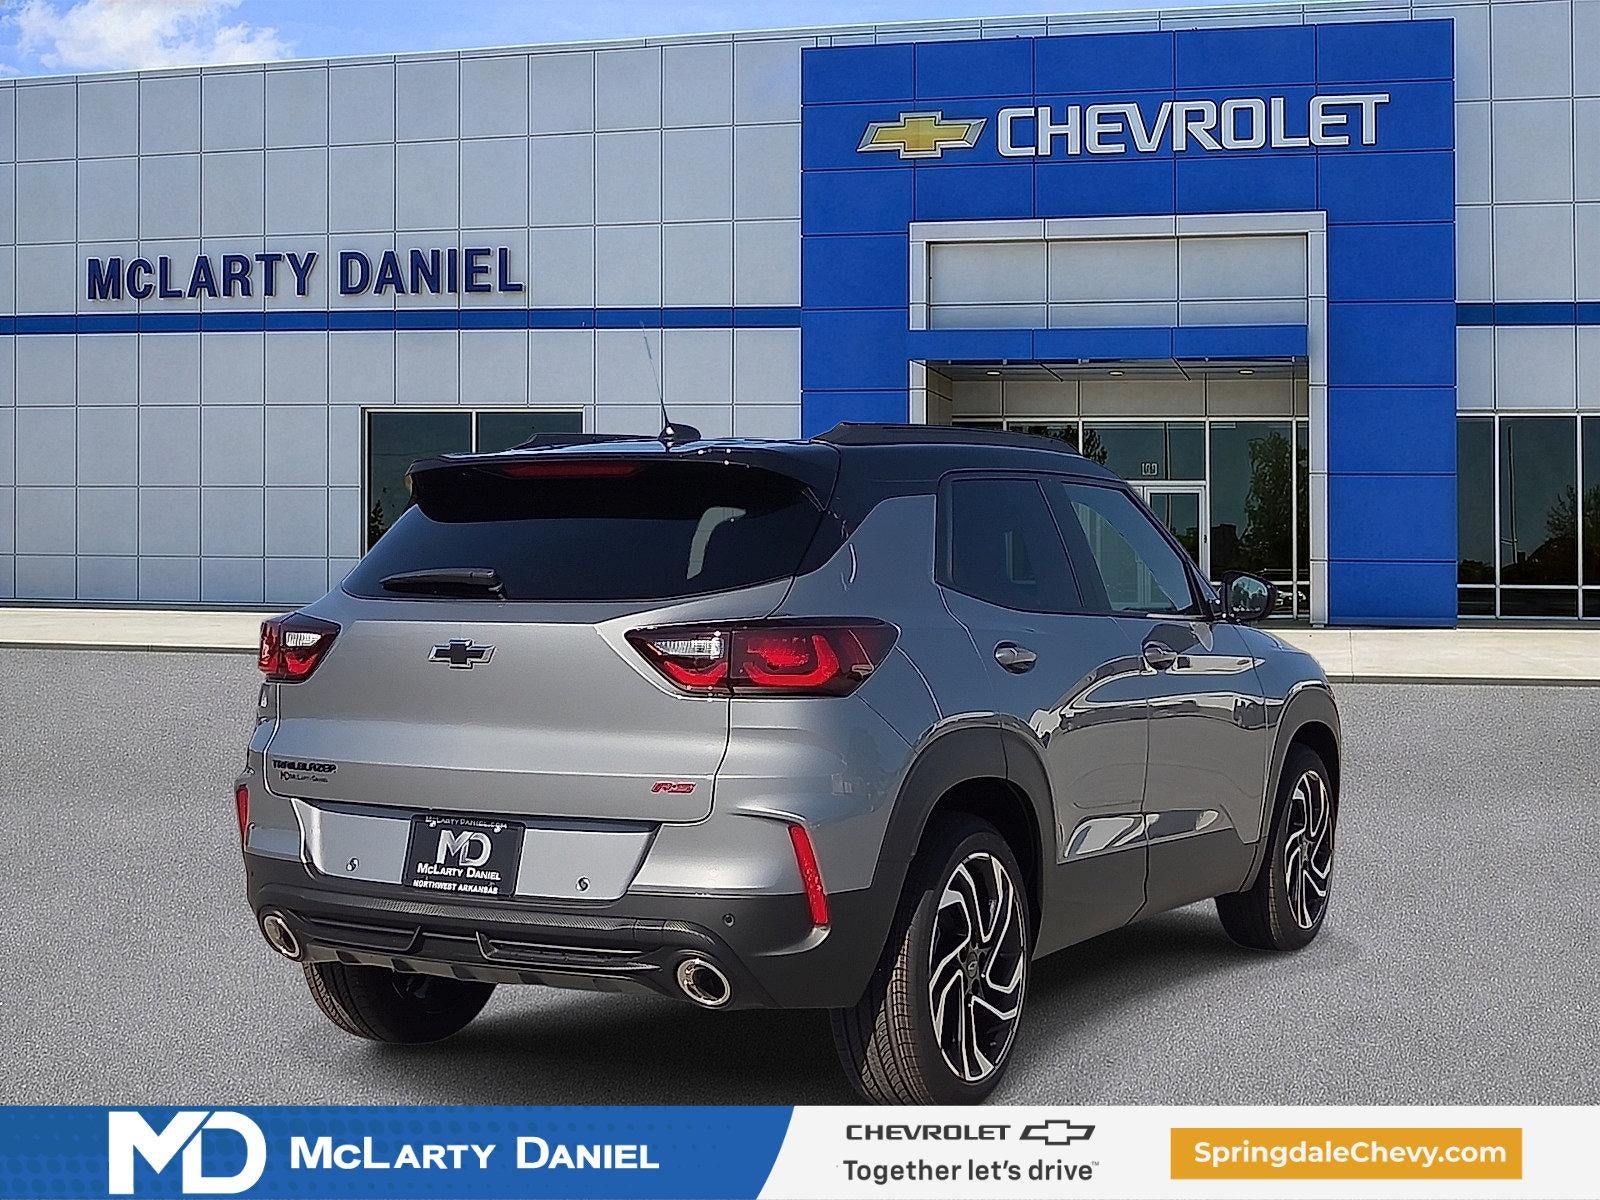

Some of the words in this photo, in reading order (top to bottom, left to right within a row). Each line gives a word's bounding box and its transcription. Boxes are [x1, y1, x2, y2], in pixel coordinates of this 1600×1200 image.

[998, 94, 1390, 157] CHEVROLET
[339, 246, 525, 295] DANIEL
[271, 759, 338, 773] TRAILBLAZER
[436, 829, 492, 867] MD
[413, 879, 457, 891] NORTHWEST
[458, 884, 498, 895] ARKANSAS
